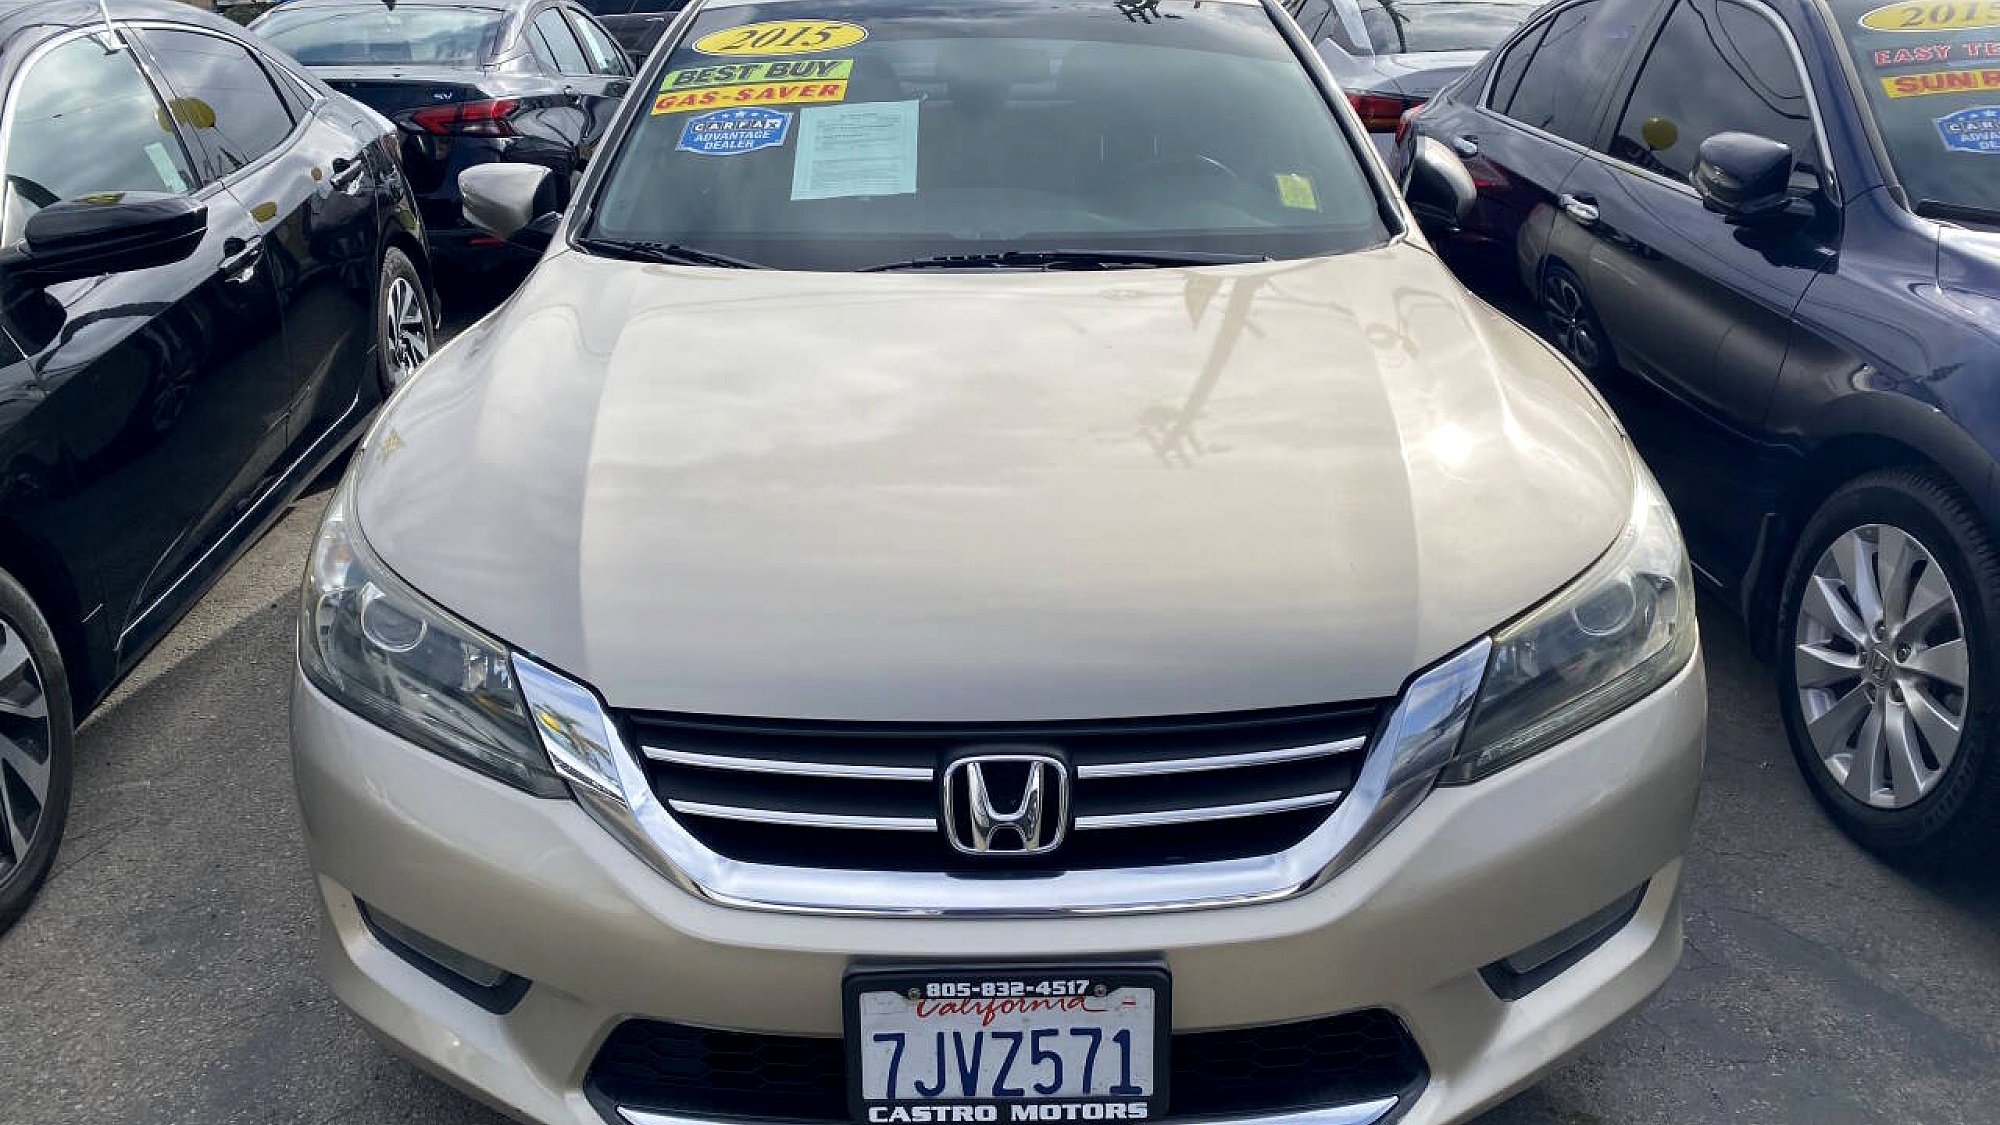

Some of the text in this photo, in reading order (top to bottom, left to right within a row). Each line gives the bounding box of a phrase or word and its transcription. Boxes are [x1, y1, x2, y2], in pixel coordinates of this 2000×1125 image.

[717, 26, 842, 51] 2015
[1874, 44, 1951, 64] EASY
[672, 60, 841, 87] BEST BUY
[1895, 71, 1979, 93] SUN
[655, 84, 841, 110] GAS-SAVER
[694, 119, 782, 132] CARFAX
[694, 130, 772, 143] ADVANTAGE
[704, 139, 754, 150] DEALER
[925, 979, 1091, 998] 805-832-4517
[916, 994, 1109, 1027] California
[872, 1026, 1143, 1099] 7JVZ571
[868, 1101, 1149, 1123] CASTRO MOTORS
